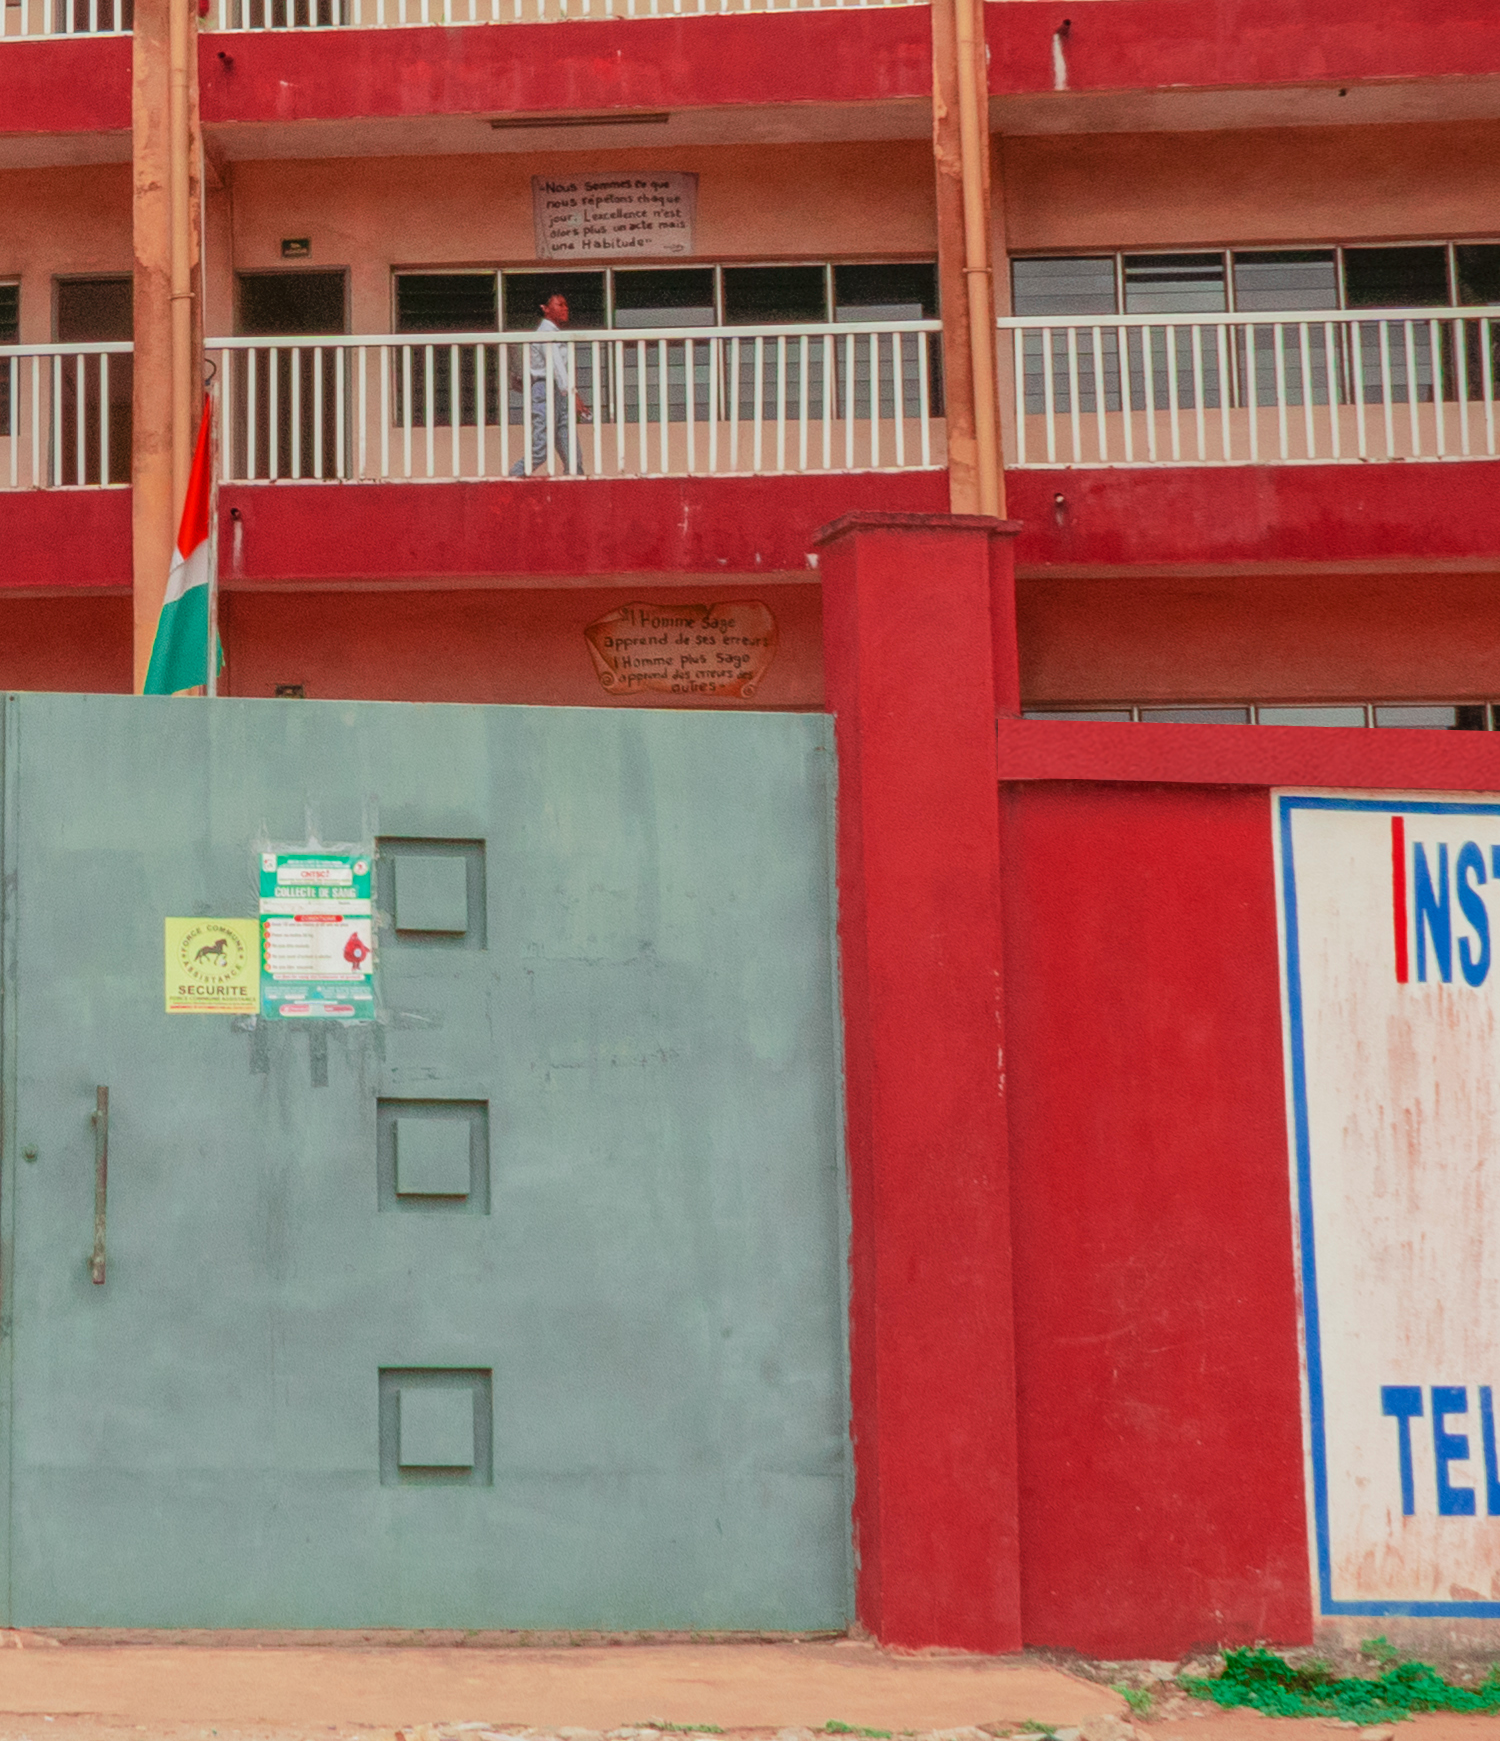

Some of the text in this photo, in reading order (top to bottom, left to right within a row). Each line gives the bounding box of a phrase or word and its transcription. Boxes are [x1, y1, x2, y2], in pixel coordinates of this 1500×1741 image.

[650, 180, 671, 192] que
[546, 197, 578, 209] nous
[637, 192, 682, 206] chaque
[550, 219, 686, 239] alors plus un acte mais
[551, 242, 575, 253] une
[701, 615, 737, 635] Sage
[604, 633, 668, 652] apprend
[674, 633, 690, 646] de
[695, 634, 717, 646] ses
[680, 652, 707, 669] plus
[274, 886, 317, 899] COLLECTE
[331, 887, 357, 899] SANG
[178, 985, 248, 996] SECURITE
